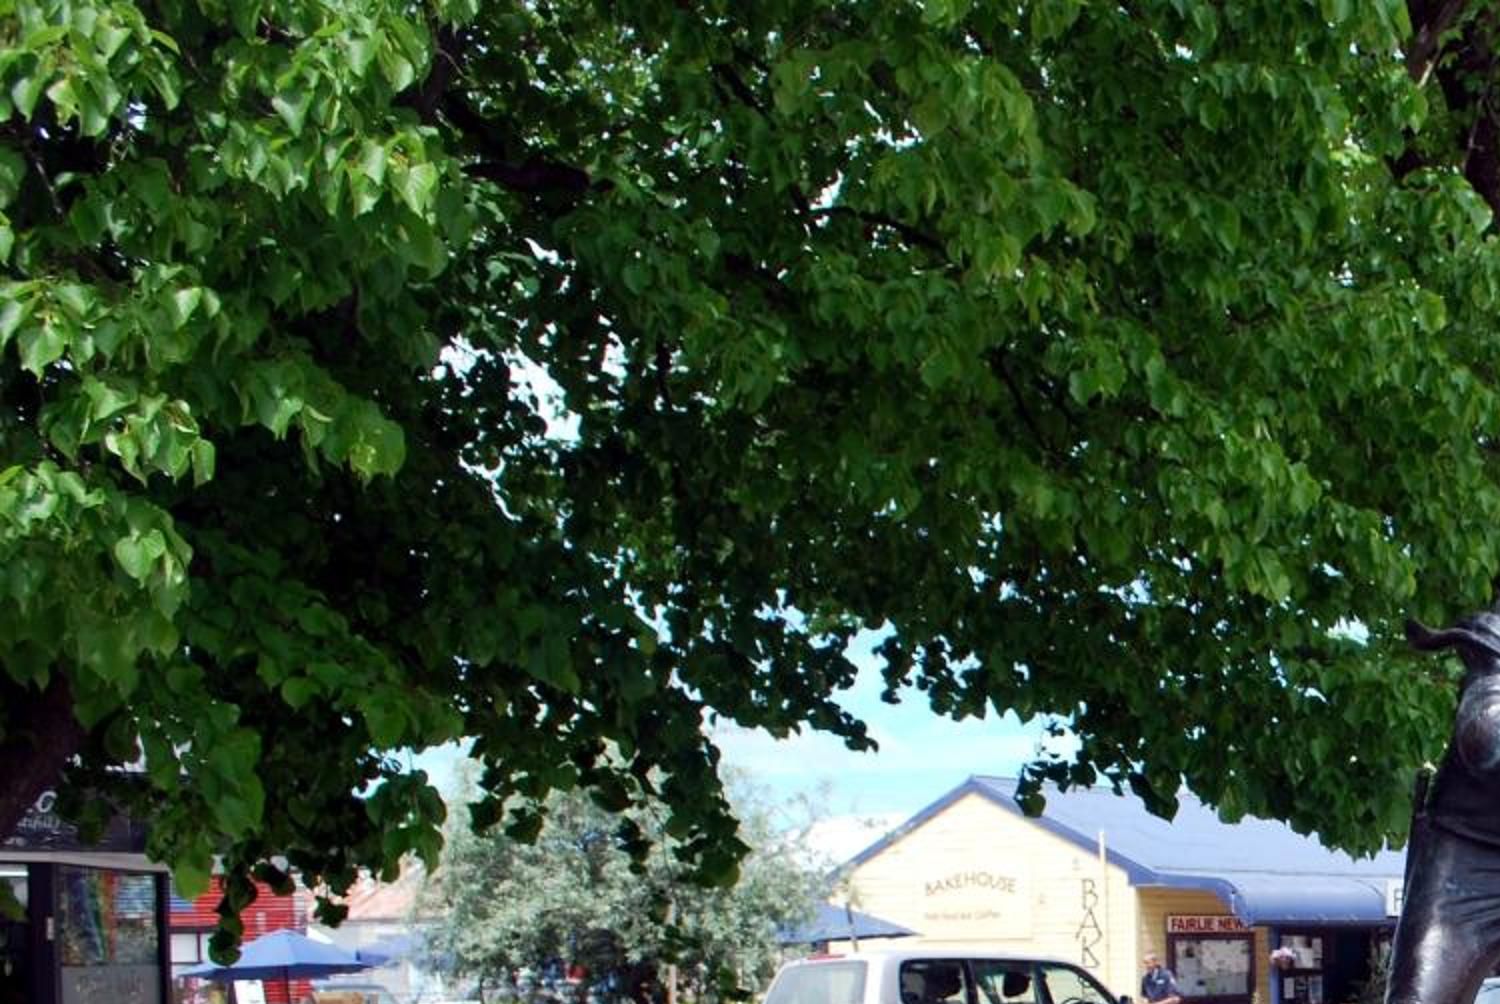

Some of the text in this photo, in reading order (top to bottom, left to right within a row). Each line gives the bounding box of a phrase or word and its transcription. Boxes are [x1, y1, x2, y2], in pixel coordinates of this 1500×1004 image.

[924, 871, 1017, 897] BAKEHOUSE
[1171, 917, 1247, 931] FAIRLIE NEW
